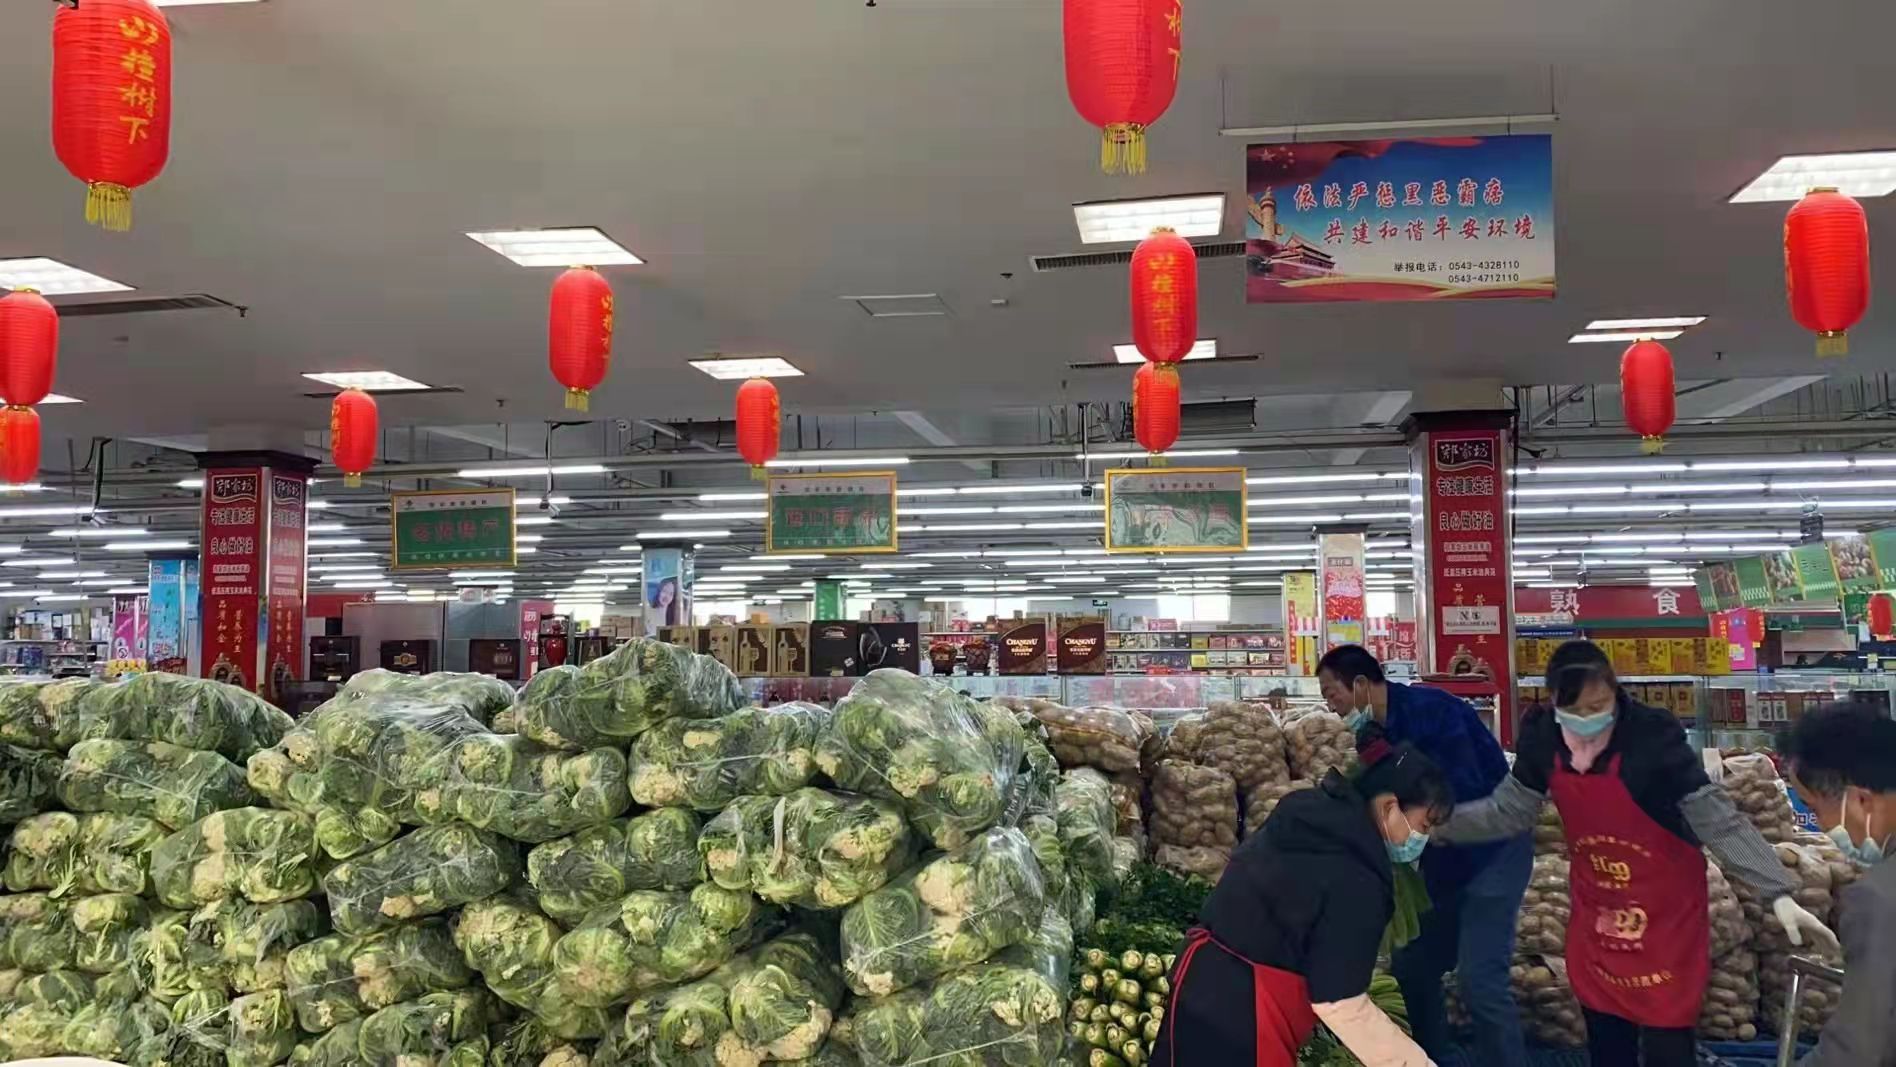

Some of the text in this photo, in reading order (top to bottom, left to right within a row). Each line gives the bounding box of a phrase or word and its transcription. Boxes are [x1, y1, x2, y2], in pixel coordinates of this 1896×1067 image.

[1293, 177, 1504, 212] 依法严惩黑恶霸痞
[1323, 214, 1535, 245] 共建和谐平安环境
[1448, 259, 1520, 271] 0543-4328110
[1448, 272, 1519, 283] 0543-4712110
[1549, 587, 1682, 616] 熟食
[1006, 638, 1038, 647] CHANGYU
[1064, 638, 1097, 647] CHANGYU
